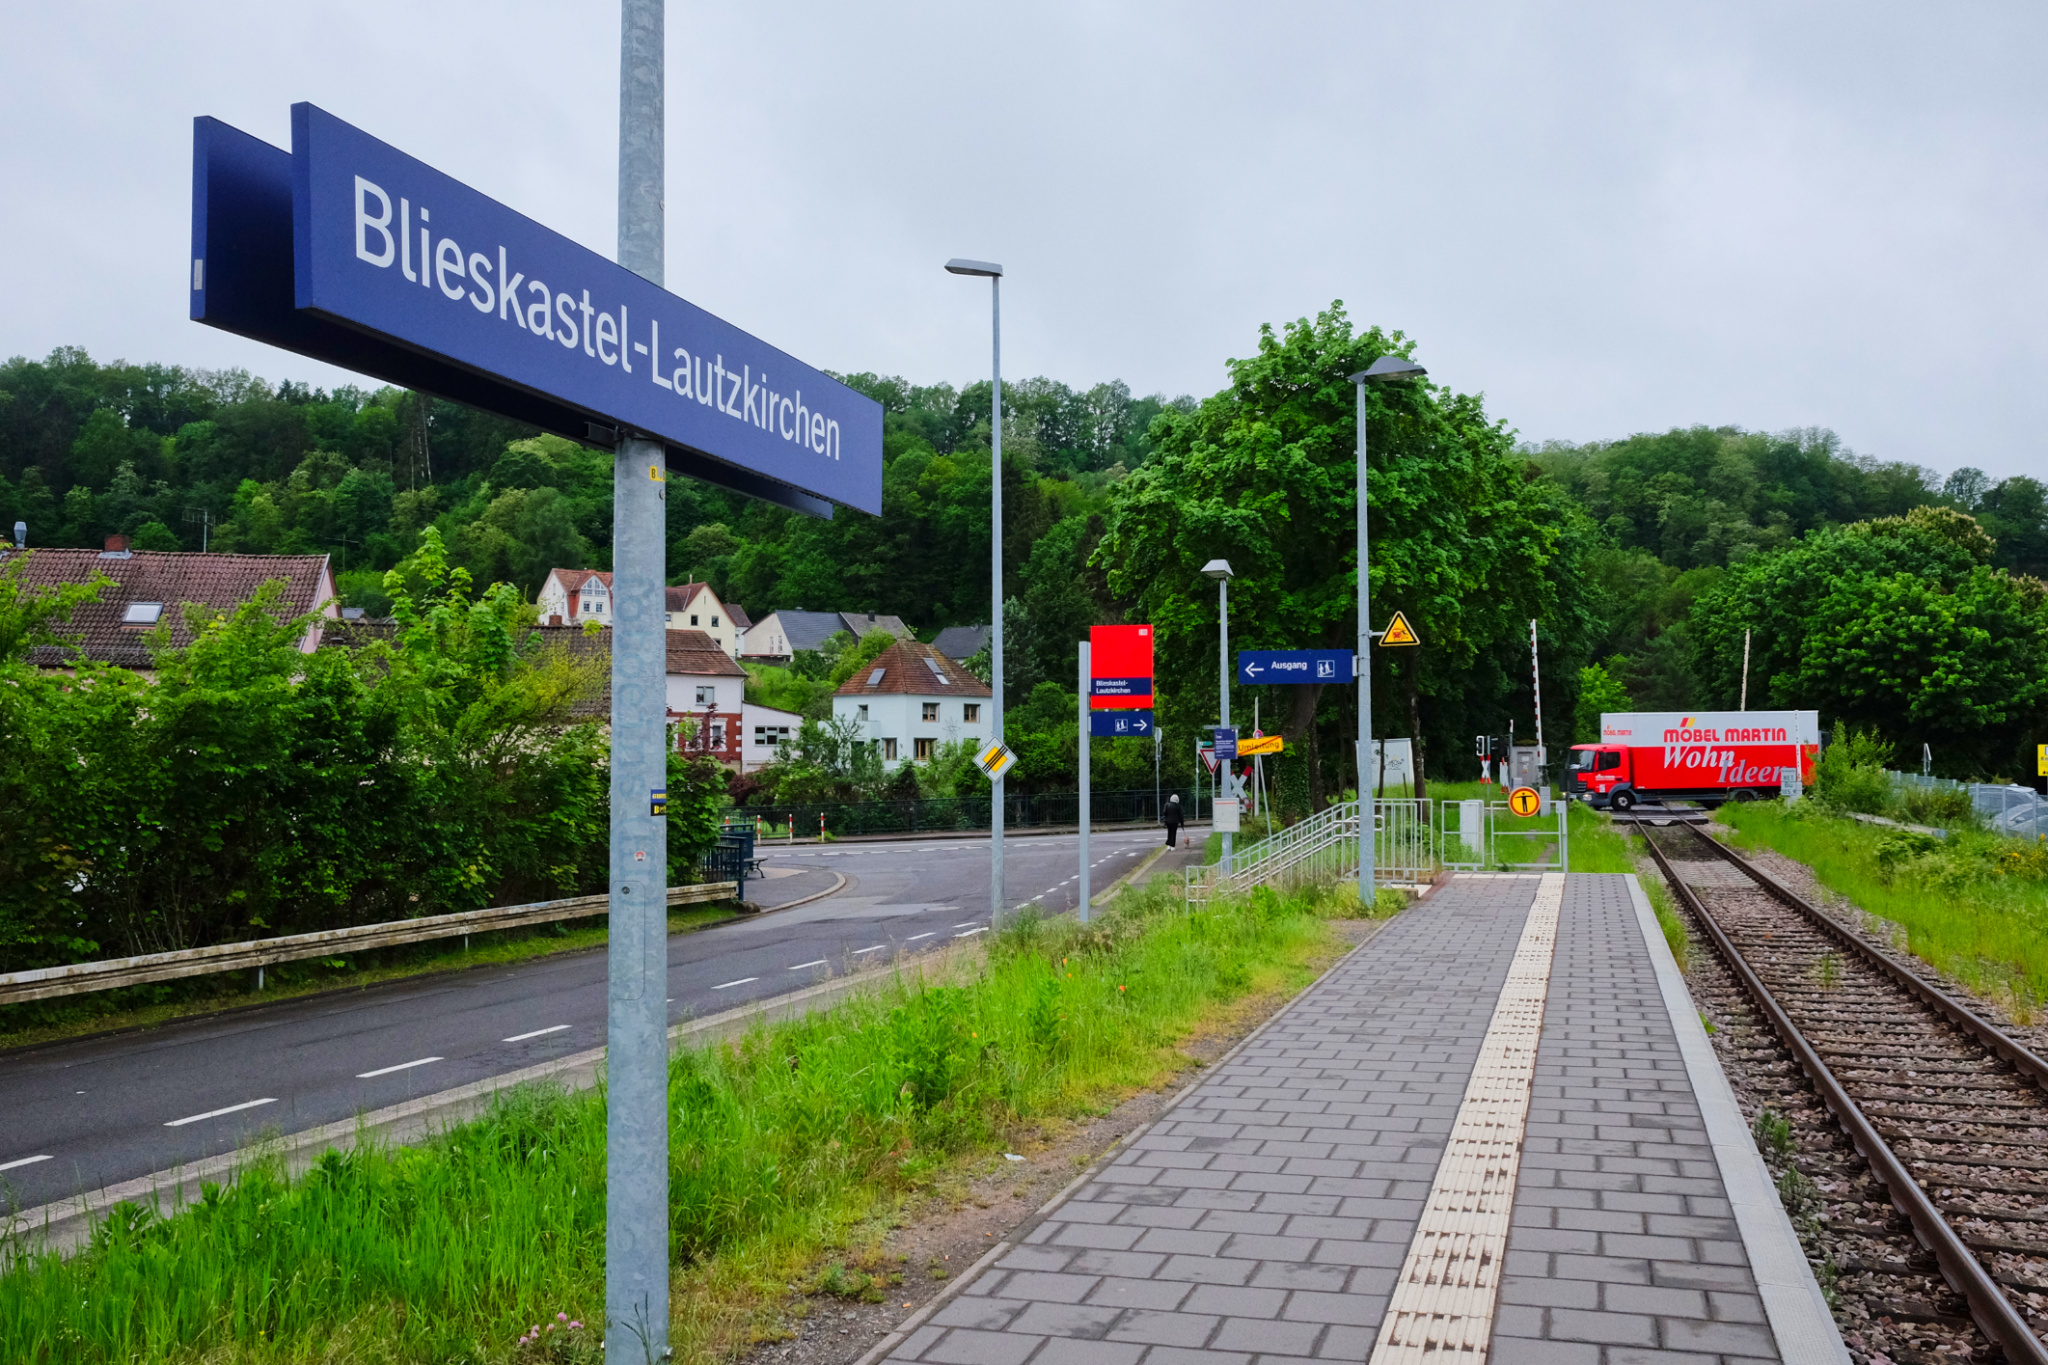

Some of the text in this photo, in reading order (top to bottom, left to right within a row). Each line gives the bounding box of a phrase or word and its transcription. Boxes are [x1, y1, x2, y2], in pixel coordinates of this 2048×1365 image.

[354, 174, 840, 460] Blieskastel-Lautzkirchen
[1271, 661, 1307, 671] Ausgang
[1724, 728, 1787, 742] MARTIN
[1238, 742, 1280, 752] Umleitung
[1664, 745, 1735, 768] Wohn
